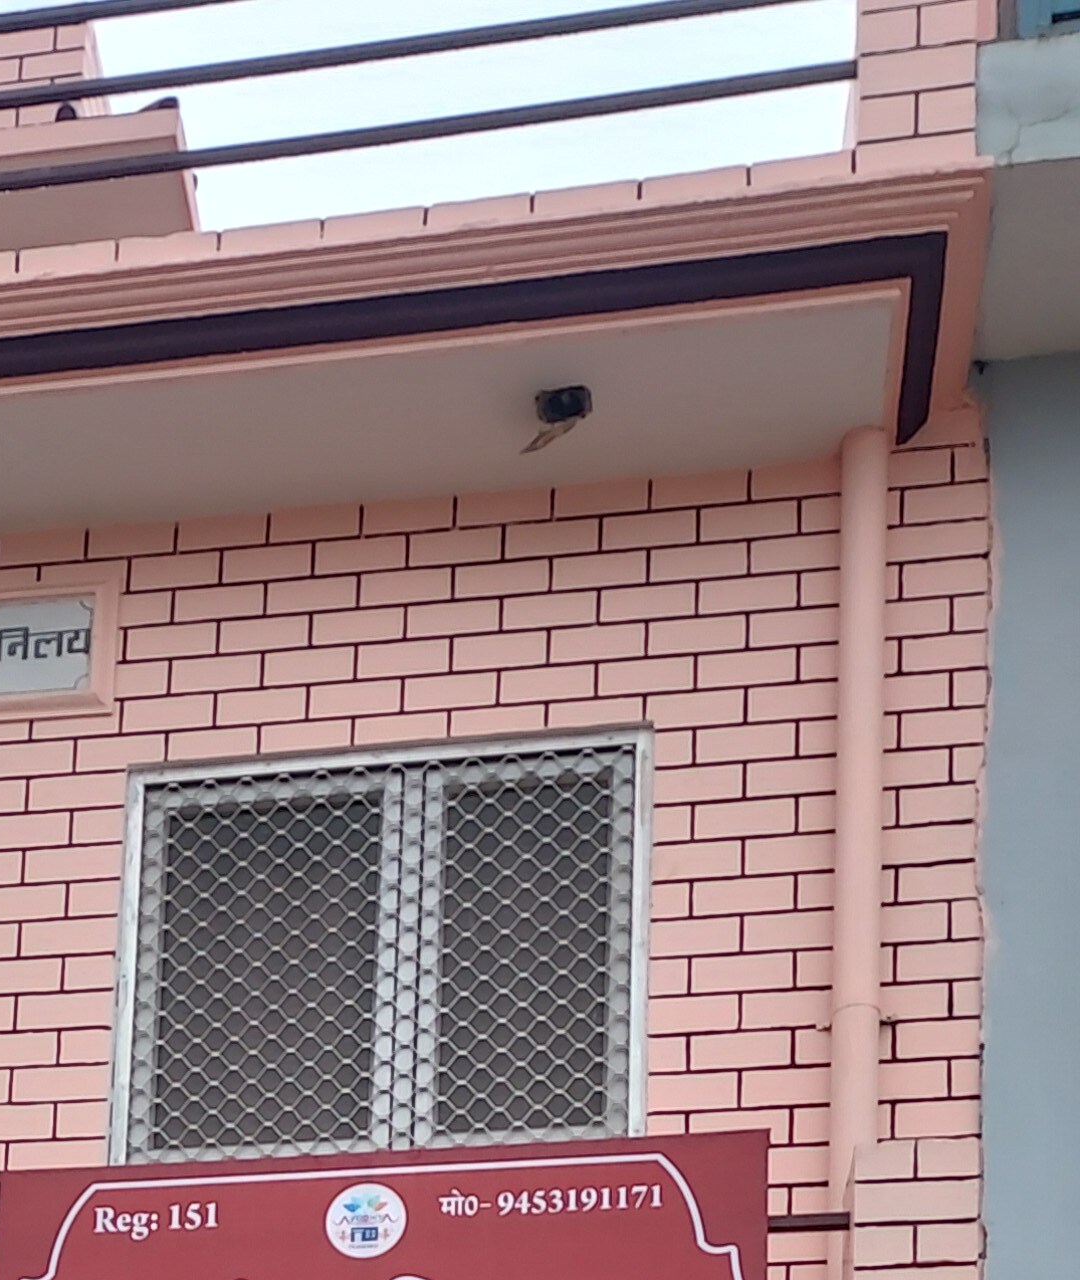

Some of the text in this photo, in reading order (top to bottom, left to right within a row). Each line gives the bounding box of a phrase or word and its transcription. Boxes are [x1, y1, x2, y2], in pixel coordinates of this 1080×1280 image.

[497, 1184, 662, 1217] 9453191171
[94, 1202, 218, 1241] Reg: 151
